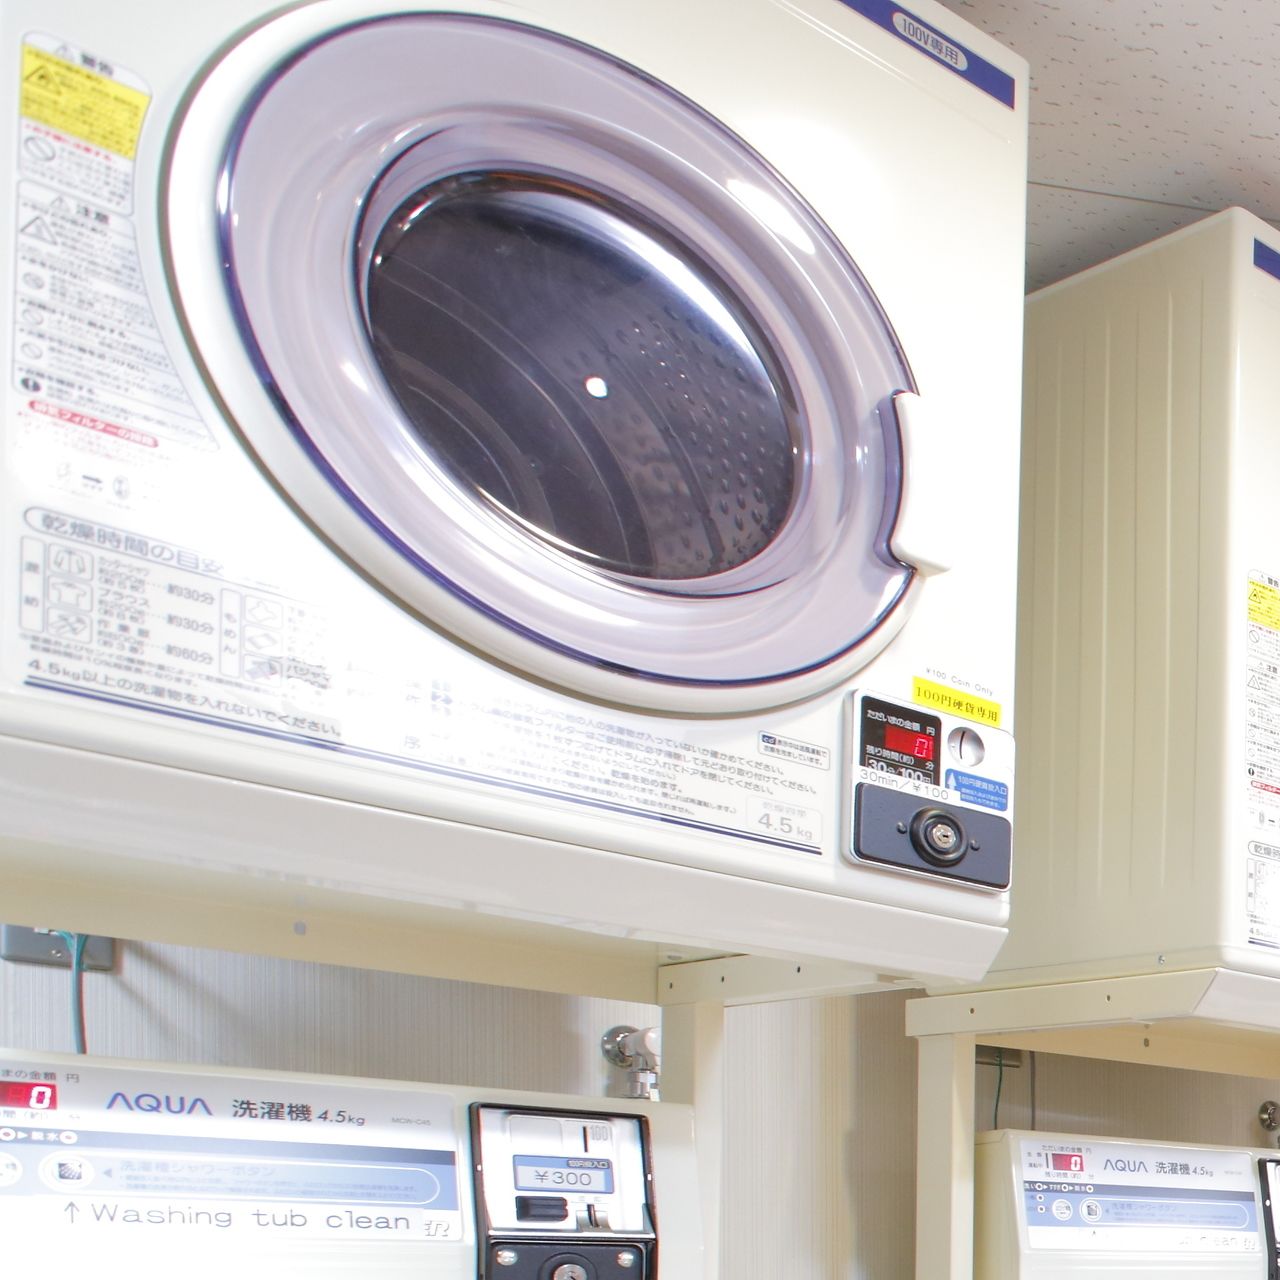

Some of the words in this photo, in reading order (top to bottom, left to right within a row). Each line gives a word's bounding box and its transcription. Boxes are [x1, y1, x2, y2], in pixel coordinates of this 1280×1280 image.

[903, 18, 958, 66] 100V専用
[951, 675, 971, 688] Coin
[974, 683, 993, 696] Only
[30, 1086, 51, 1109] 0
[106, 1091, 214, 1116] AQUA
[232, 1098, 312, 1122] 洗濯機
[317, 1110, 366, 1126] 4.5kg
[1070, 1157, 1081, 1170] 0
[1104, 1159, 1148, 1173] AQUA
[1155, 1161, 1190, 1176] 洗濯機
[535, 1170, 591, 1186] ¥300
[92, 1202, 232, 1229] Washing
[252, 1207, 308, 1228] tub
[326, 1210, 410, 1231] clean
